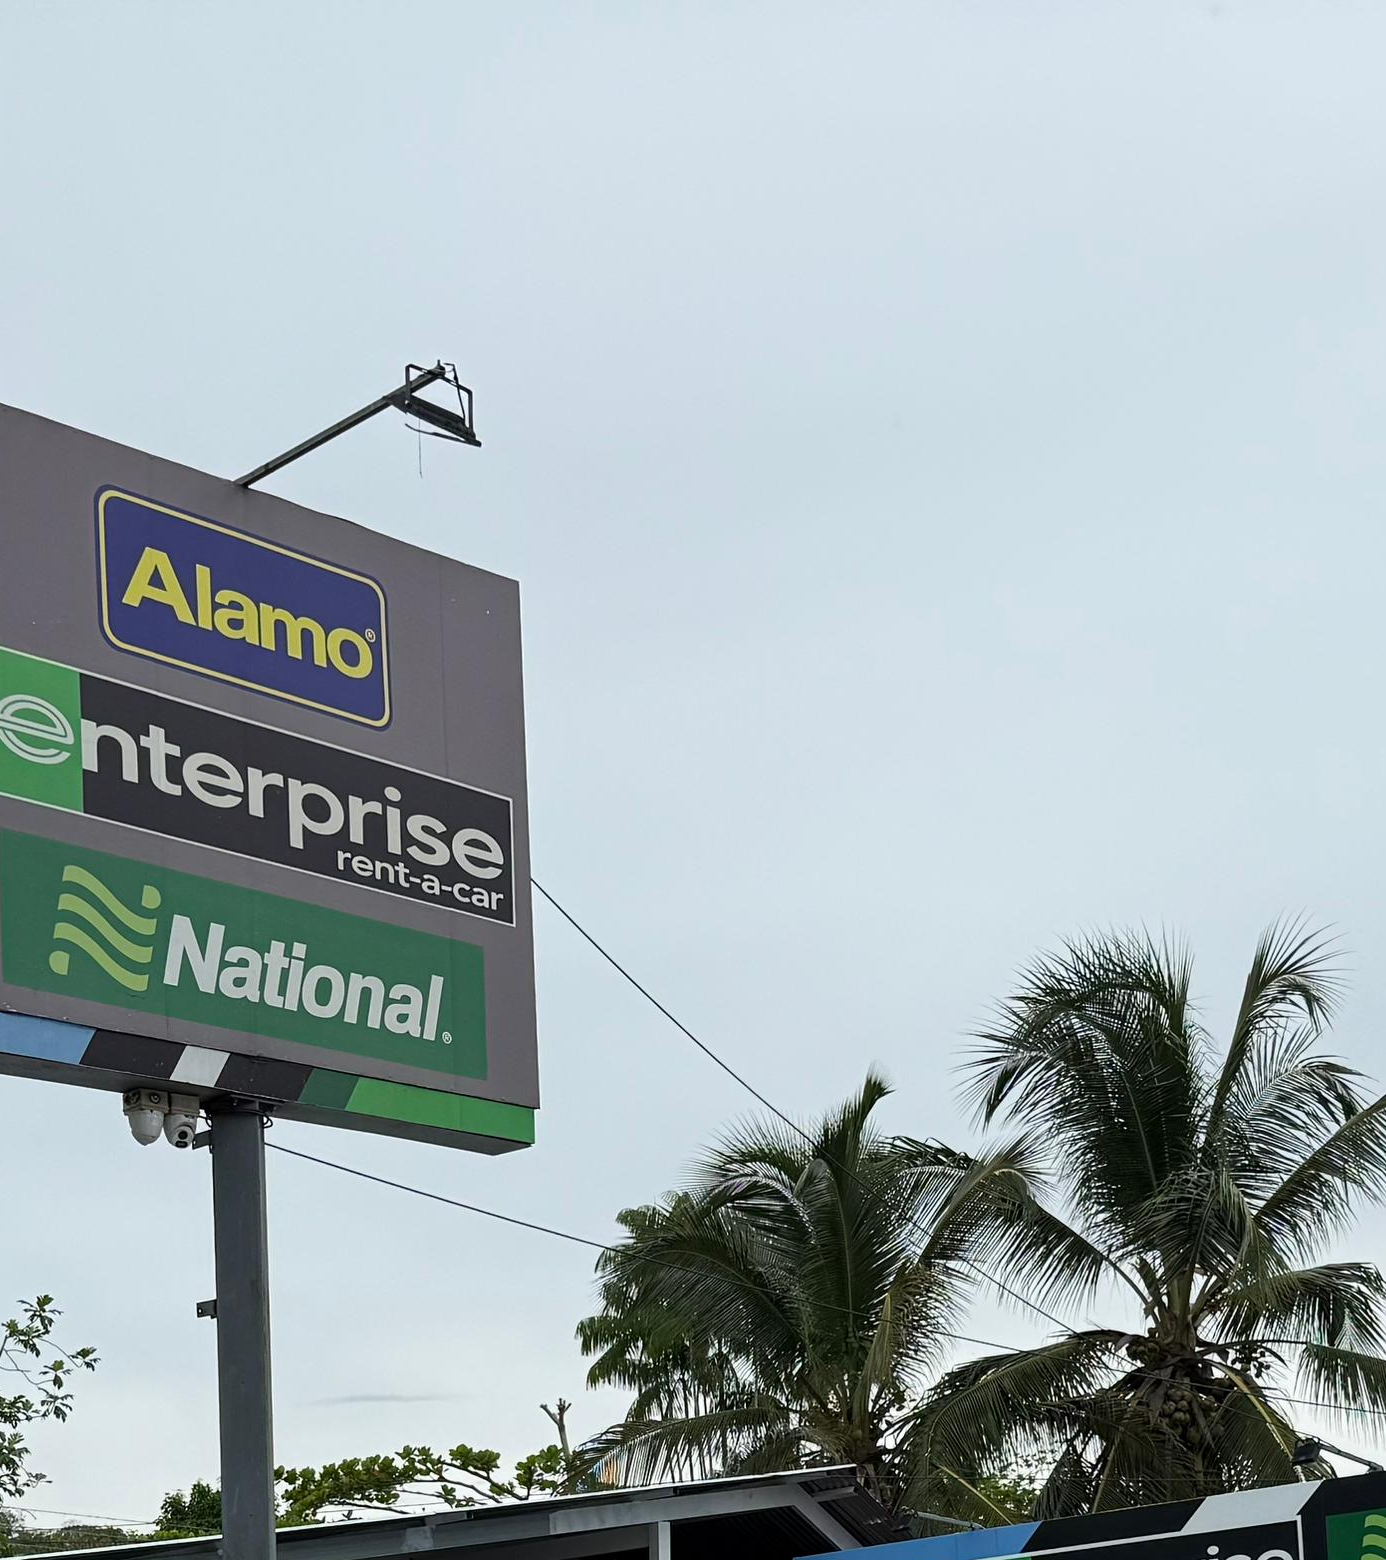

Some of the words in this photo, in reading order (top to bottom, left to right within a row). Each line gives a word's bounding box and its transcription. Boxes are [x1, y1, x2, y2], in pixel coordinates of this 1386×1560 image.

[121, 546, 374, 679] Alamo
[336, 849, 505, 911] rent-a-car
[162, 914, 446, 1042] National
